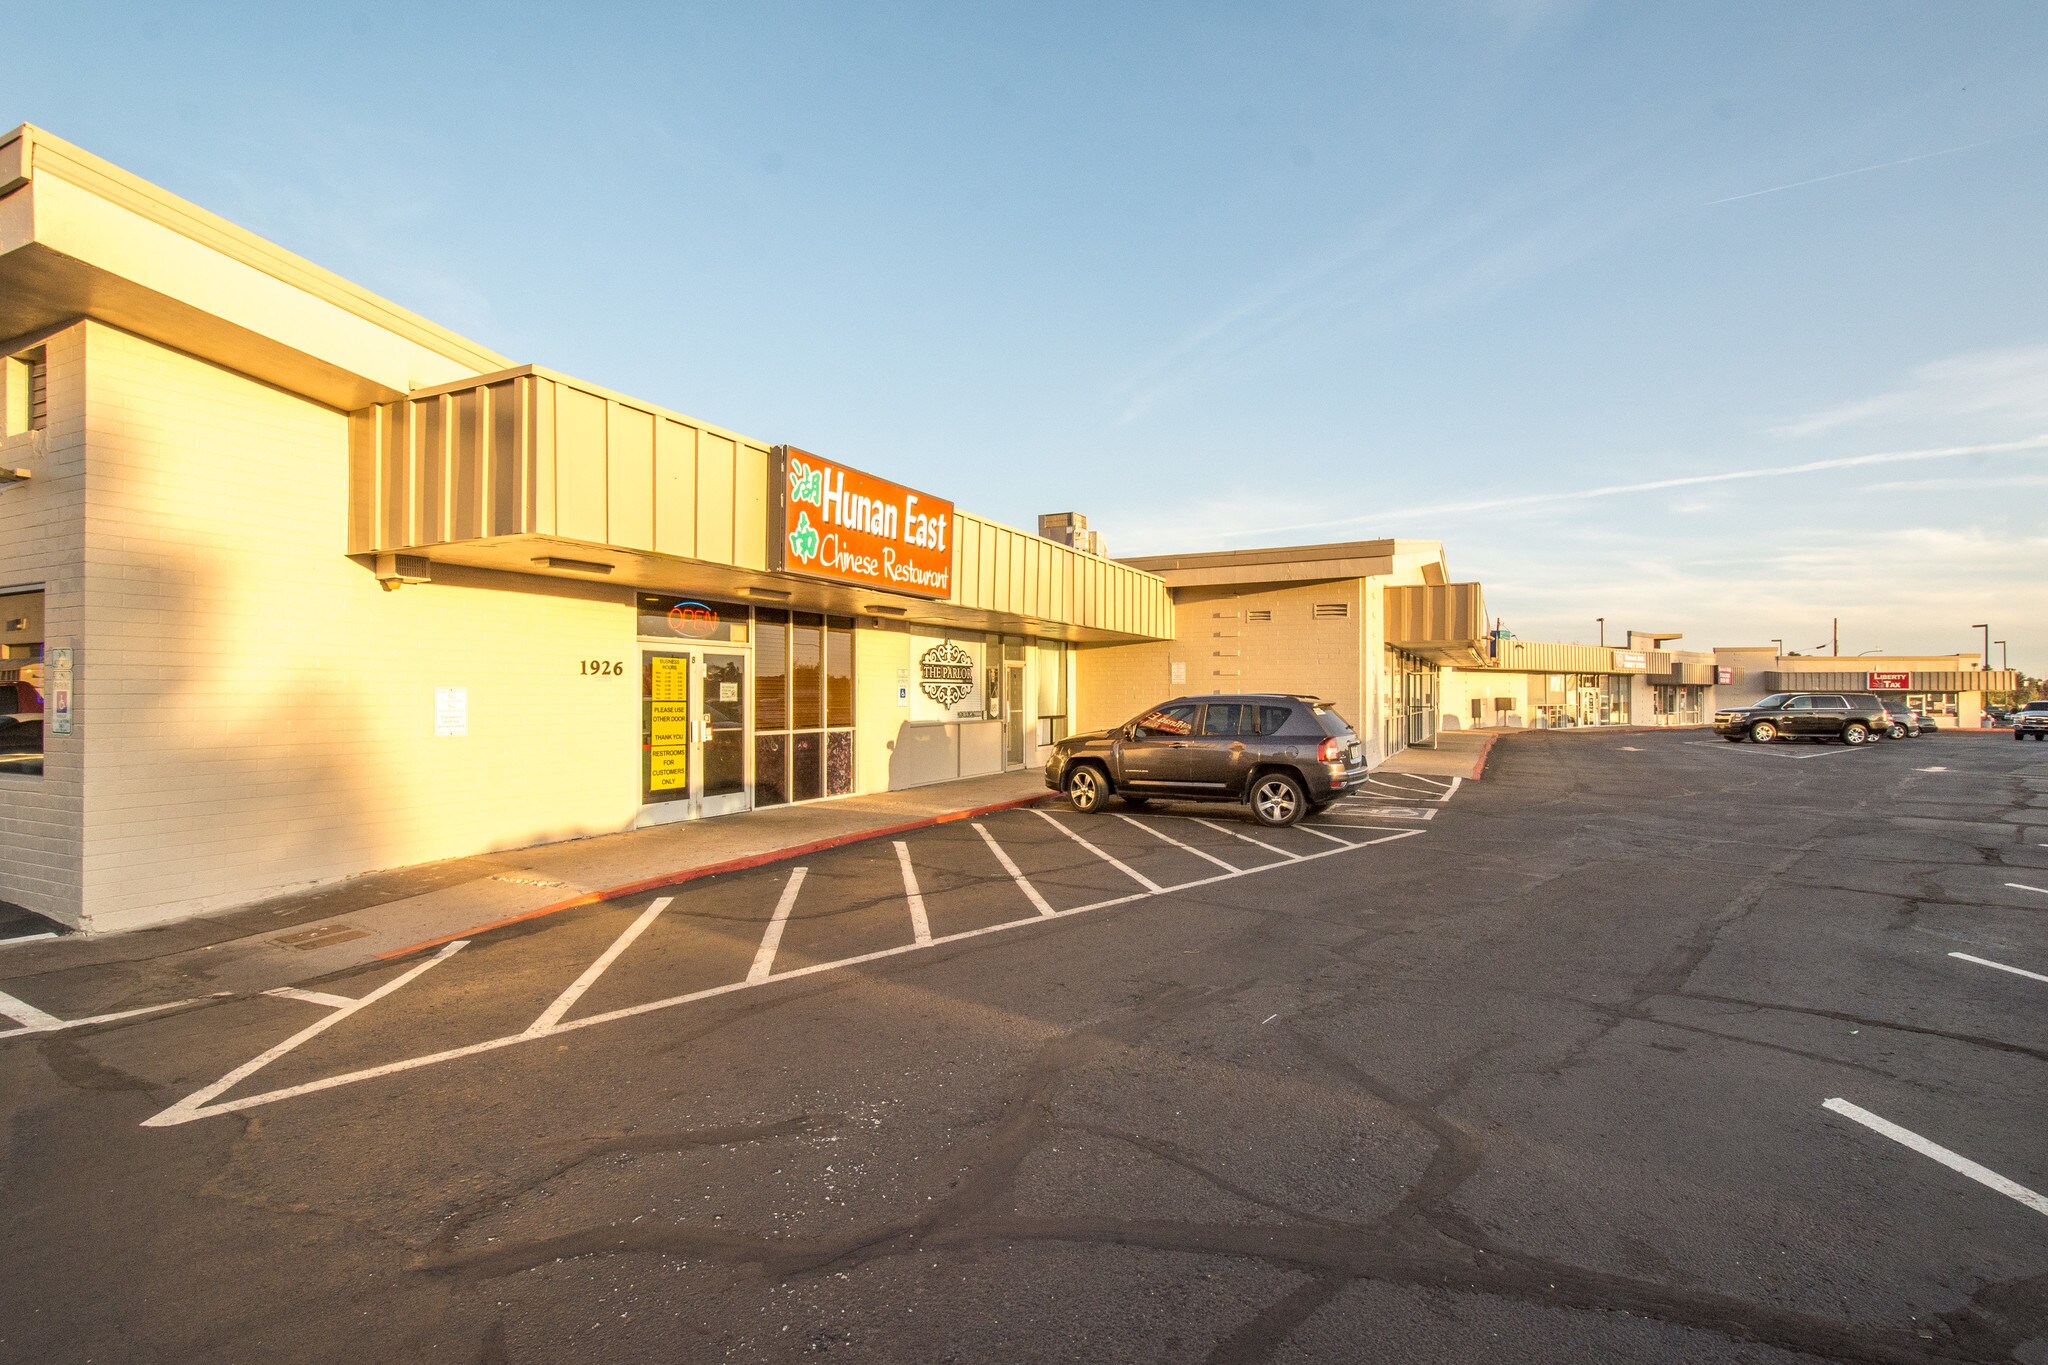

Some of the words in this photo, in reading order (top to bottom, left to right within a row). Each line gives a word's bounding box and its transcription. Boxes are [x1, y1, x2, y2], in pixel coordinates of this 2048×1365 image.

[822, 467, 897, 540] Hunan
[904, 495, 947, 552] East
[820, 534, 879, 576] Chinese
[882, 547, 949, 590] Restaurant
[668, 607, 718, 632] OPEN
[580, 660, 623, 676] 1926
[924, 666, 941, 678] THE
[943, 667, 972, 679] PARLOR
[1884, 680, 1901, 688] TAX
[653, 749, 685, 757] RESTROOMS
[652, 768, 684, 776] CUSTOMERS
